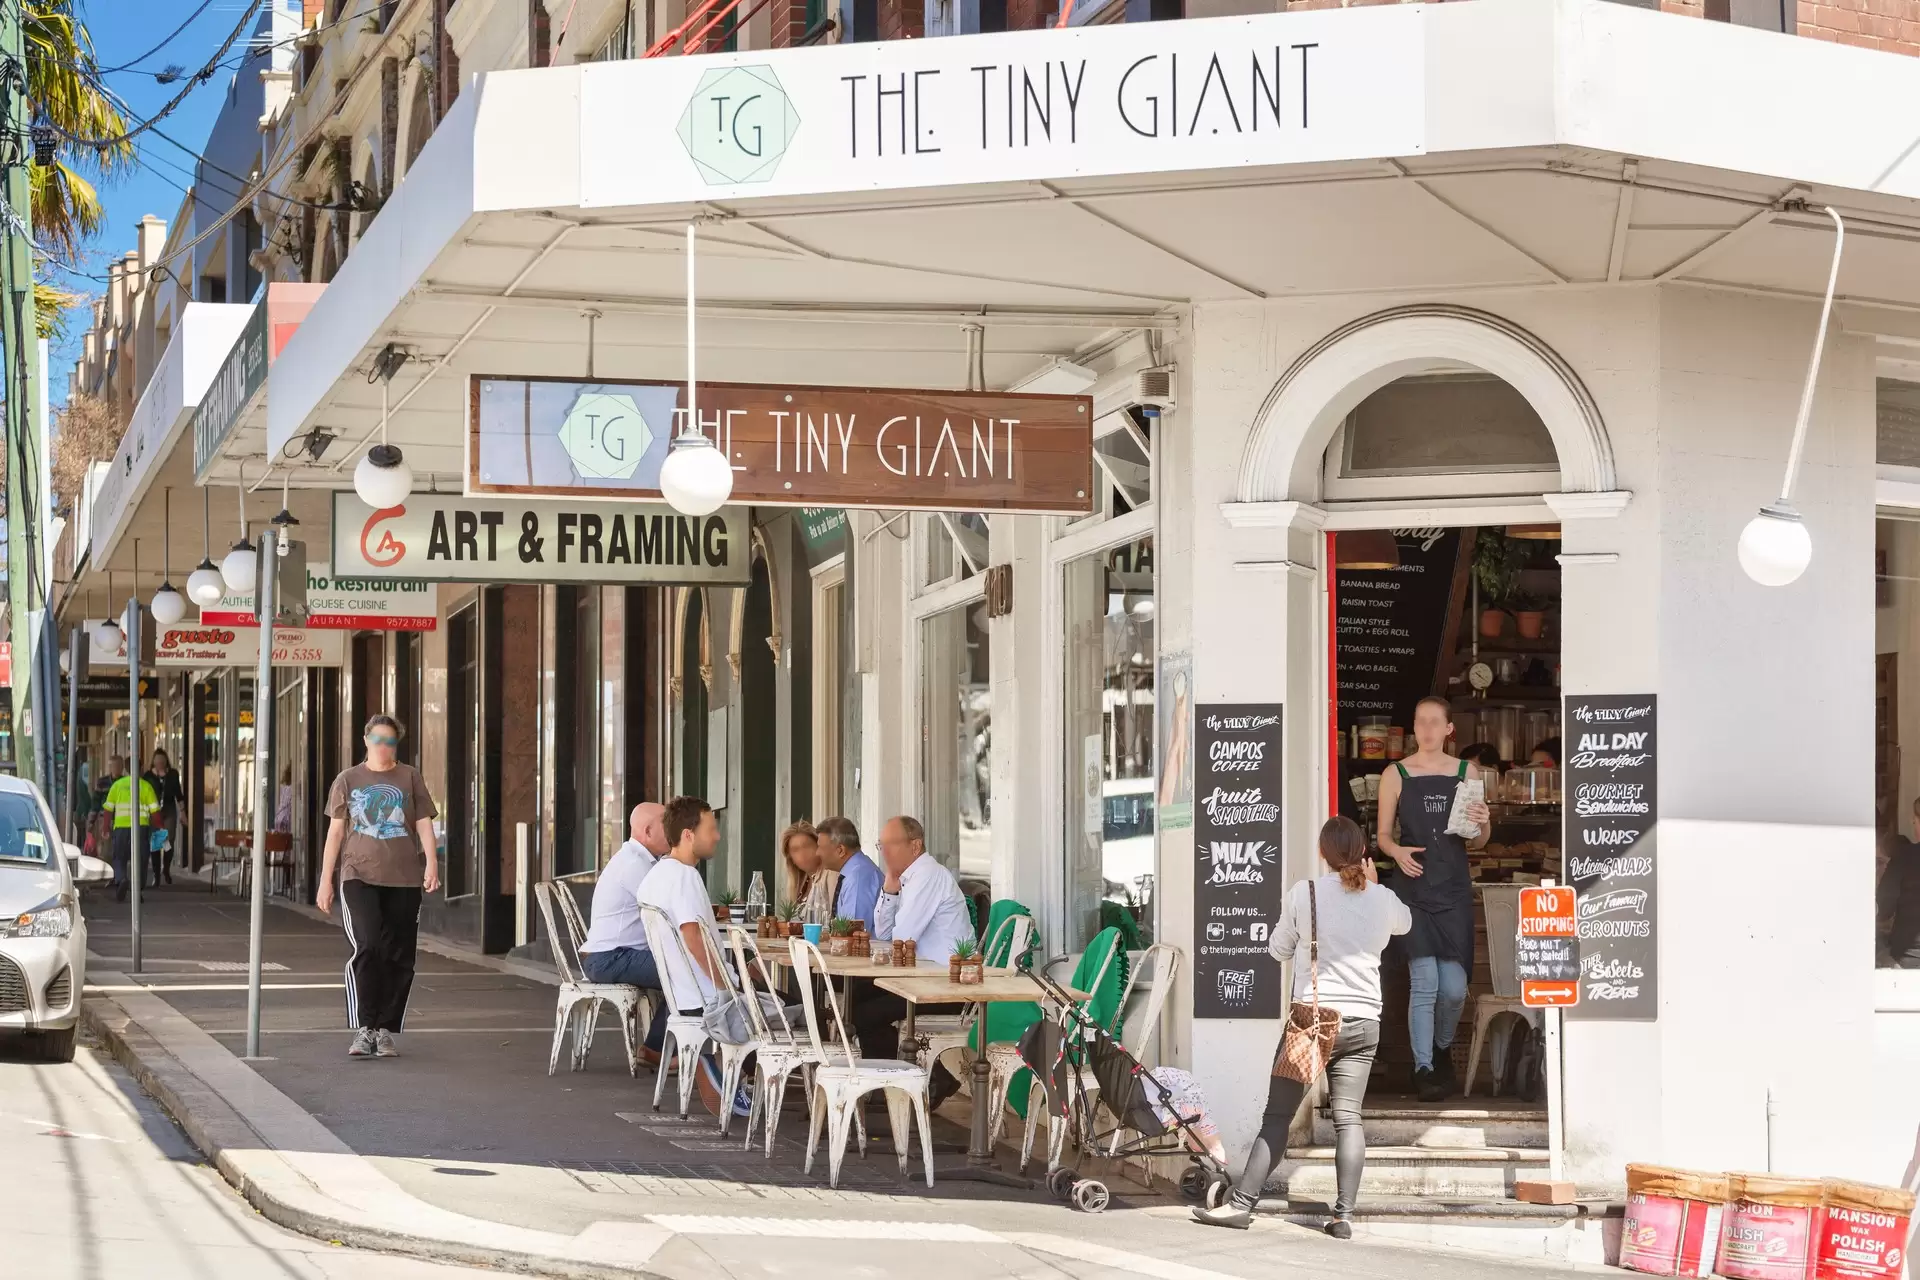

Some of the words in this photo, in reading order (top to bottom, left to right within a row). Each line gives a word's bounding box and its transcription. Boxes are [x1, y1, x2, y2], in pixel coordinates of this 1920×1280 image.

[841, 70, 941, 158] THE
[971, 59, 1087, 150] TINY
[1117, 43, 1320, 138] GIANT
[208, 339, 246, 450] FRAMING
[769, 411, 857, 475] TINY
[877, 415, 1021, 479] GIANT
[427, 510, 504, 561] ART
[518, 511, 545, 563] &
[557, 513, 728, 567] FRAMING
[306, 570, 326, 590] ho
[1340, 580, 1374, 589] BANANA
[1375, 581, 1401, 590] BREAD
[221, 595, 255, 607] AUTHE
[348, 599, 387, 610] CUISINE
[1341, 598, 1367, 607] RAISIN
[1368, 599, 1395, 608] TOAST
[386, 618, 409, 627] 9572
[411, 618, 433, 628] 7887
[1338, 617, 1368, 625] ITALIAN
[1368, 618, 1391, 626] STYLE
[162, 628, 235, 649] gusto
[1336, 627, 1364, 635] CUITTO
[1372, 628, 1389, 636] EGG
[1391, 628, 1410, 637] ROLL
[292, 648, 322, 661] 5358
[1344, 645, 1380, 654] TOASTIES
[1388, 647, 1415, 655] WRAPS
[1355, 664, 1372, 672] AVO
[1373, 665, 1398, 673] BAGEL
[1355, 682, 1380, 690] SALAD
[1357, 701, 1394, 709] CRONUTS
[1595, 708, 1624, 720] TINY
[1223, 717, 1250, 729] TINY
[1578, 733, 1609, 751] ALL
[1612, 732, 1648, 750] DAY
[1210, 741, 1266, 760] CAMPOS
[1212, 760, 1262, 772] COFFEE
[1570, 751, 1652, 772] Breakfast
[1575, 783, 1644, 800] GOURMET
[1201, 787, 1262, 815] fruit
[1575, 799, 1649, 815] Sandwiches
[1211, 804, 1280, 826] SMOOTHIES
[1583, 827, 1639, 845] WRAPS
[1210, 841, 1266, 866] MILK
[1205, 863, 1264, 885] Shakes
[1601, 857, 1652, 880] SALADS
[1536, 893, 1558, 913] NO
[1603, 893, 1639, 909] Famous
[1211, 907, 1246, 917] FOLLOW
[1522, 916, 1574, 933] STOPPING
[1578, 920, 1650, 938] CRONUTS
[1224, 970, 1250, 985] FREE
[1590, 959, 1644, 979] Sweets
[1828, 1207, 1896, 1229] MANSION
[1850, 1226, 1870, 1235] WAX
[1831, 1233, 1886, 1253] POLISH
